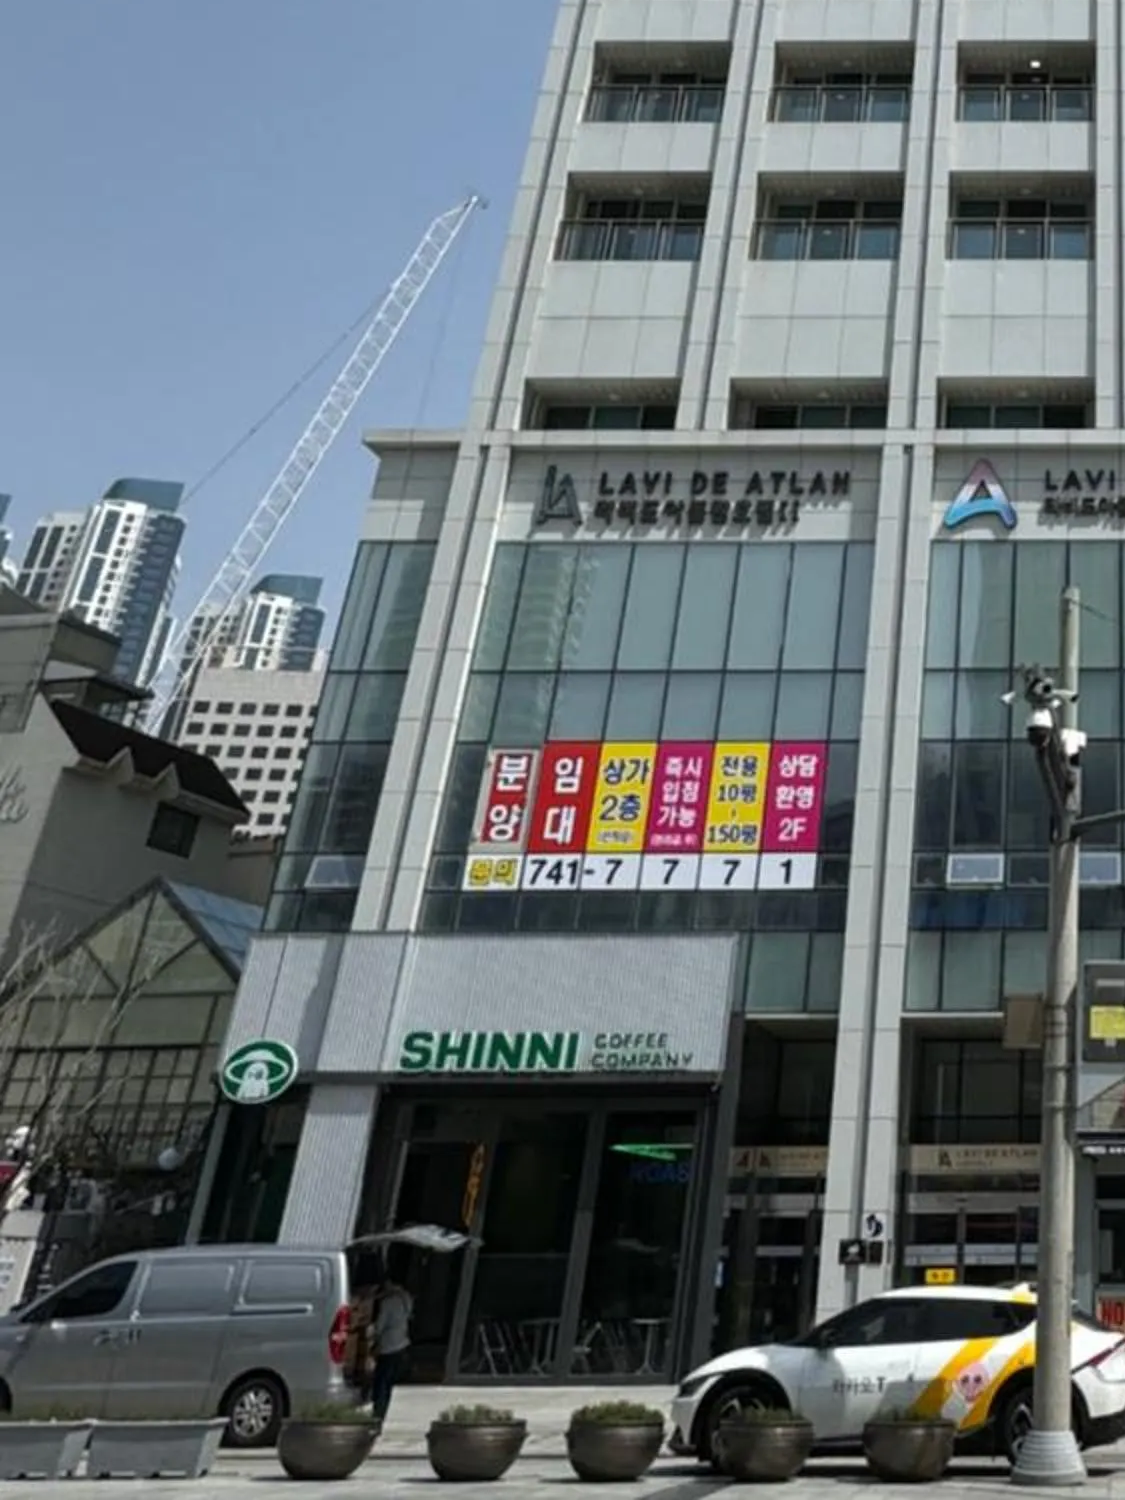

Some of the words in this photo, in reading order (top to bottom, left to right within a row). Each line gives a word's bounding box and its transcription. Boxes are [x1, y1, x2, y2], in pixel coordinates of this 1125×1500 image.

[599, 472, 673, 495] LAVI
[691, 471, 729, 495] DE
[747, 471, 850, 496] ATLAN
[1045, 469, 1115, 491] LAVI
[603, 758, 650, 785] 상가
[664, 756, 703, 780] 즉시
[721, 755, 758, 778] 전용
[779, 754, 817, 778] 상담
[488, 754, 529, 842] 분양
[543, 755, 585, 844] 임대
[662, 781, 699, 804] 입점
[717, 784, 757, 804] 10평
[775, 785, 814, 810] 환영
[599, 793, 641, 822] 2층
[656, 806, 697, 828] 가능
[708, 824, 757, 845] 150평
[778, 817, 807, 843] 2F
[400, 1031, 579, 1070] SHINNI
[594, 1033, 669, 1049] COFFEE
[591, 1053, 695, 1069] COMPANY
[1101, 1300, 1125, 1326] NO
